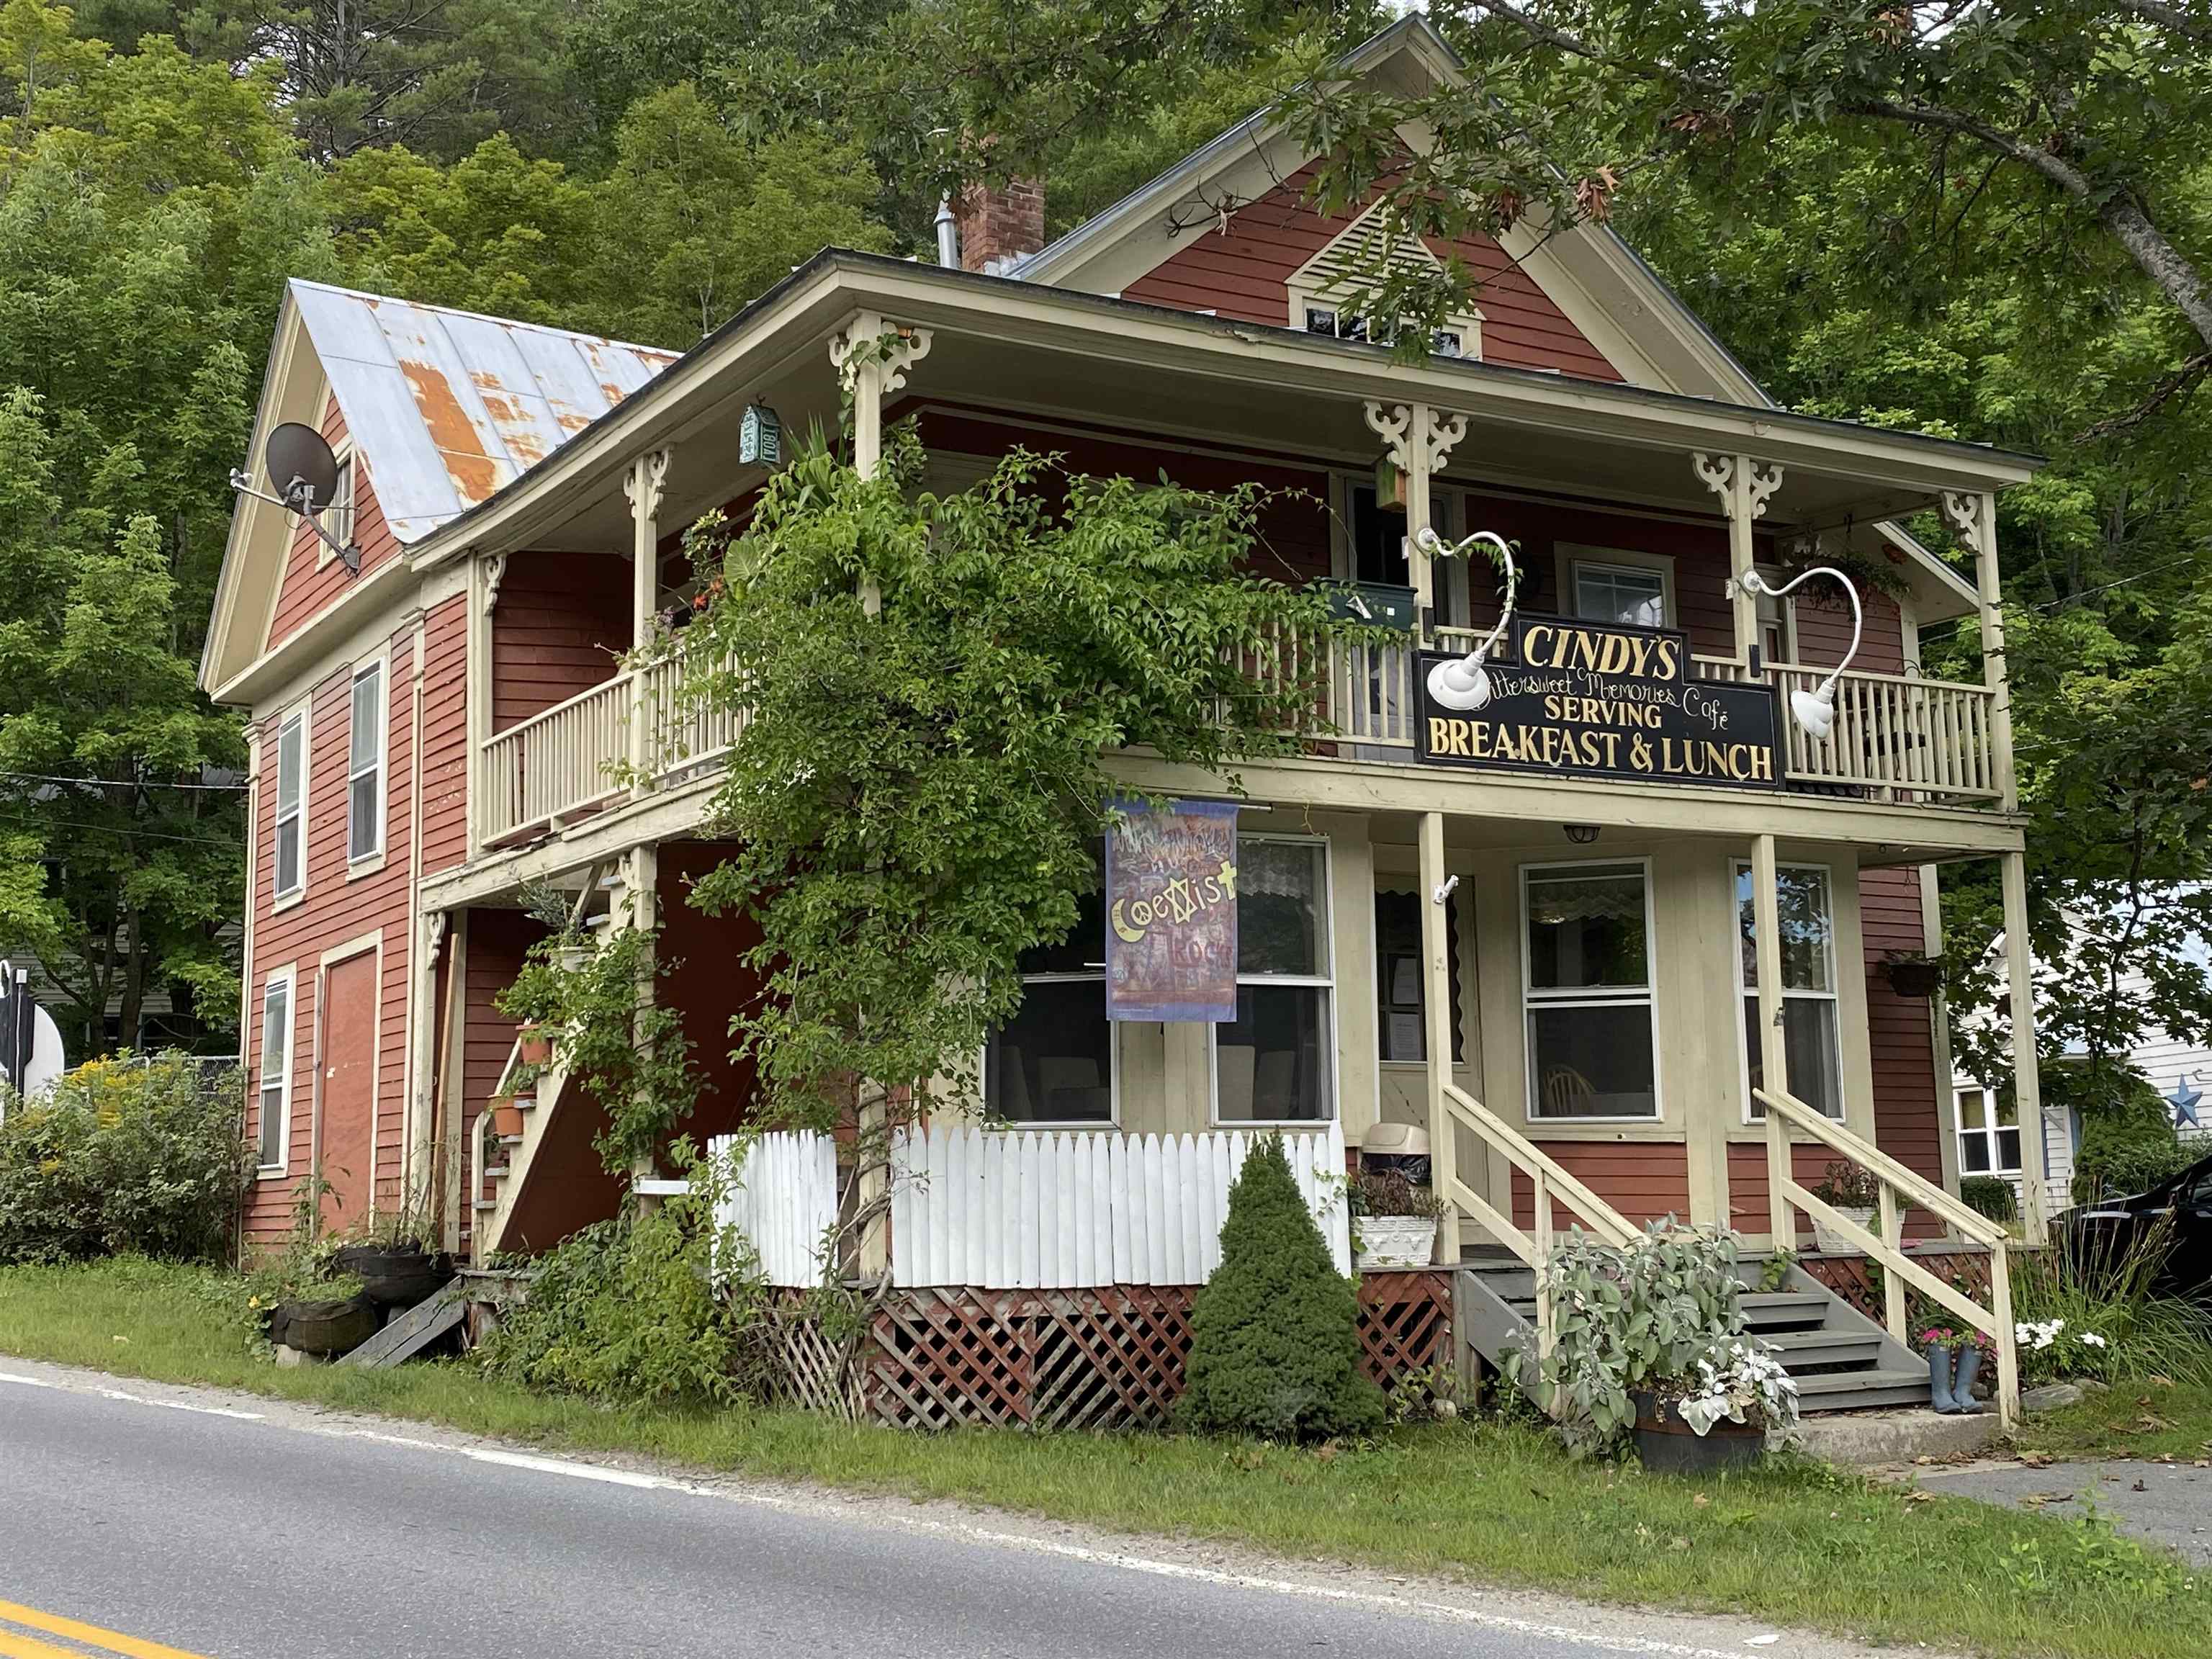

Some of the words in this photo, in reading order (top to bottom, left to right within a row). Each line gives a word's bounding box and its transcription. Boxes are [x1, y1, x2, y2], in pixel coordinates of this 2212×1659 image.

[1524, 625, 1680, 680] CINDY'S
[1471, 669, 1577, 711] ittersweet
[1576, 667, 1681, 708] Memories
[1545, 695, 1662, 729] SERVING
[1428, 717, 1621, 768] BREAKFAST
[1629, 732, 1653, 773] &
[1661, 737, 1773, 781] LUNCH
